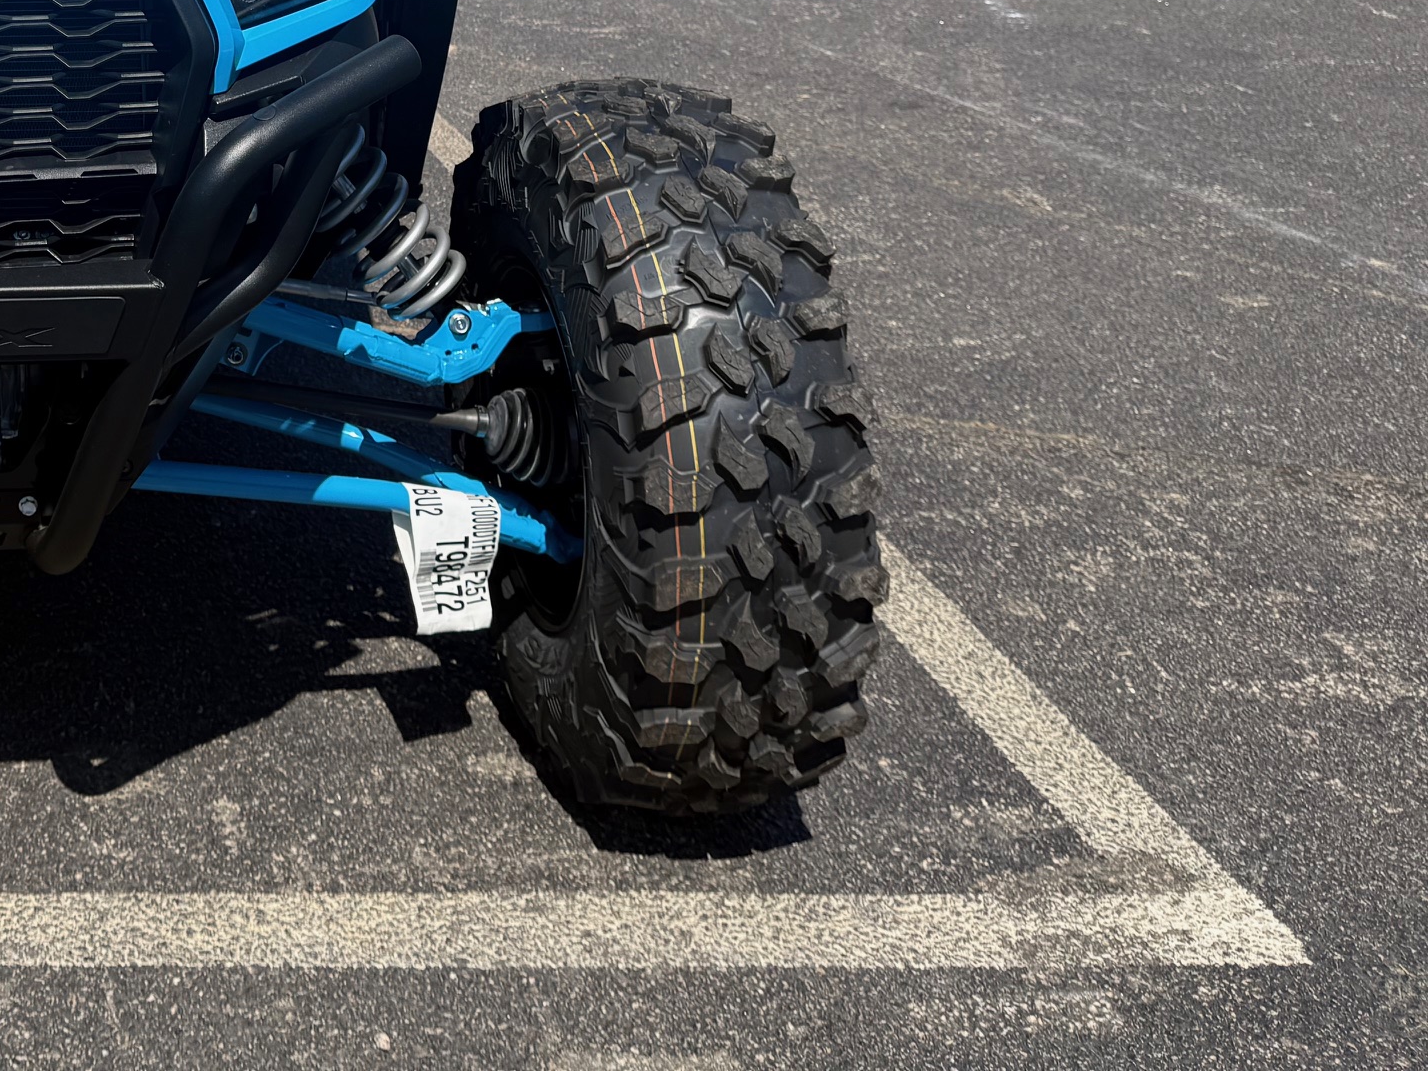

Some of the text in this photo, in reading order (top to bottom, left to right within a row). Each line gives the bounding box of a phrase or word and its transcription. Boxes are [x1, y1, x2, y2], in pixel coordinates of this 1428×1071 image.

[412, 488, 444, 517] BU2
[432, 535, 469, 615] T98472
[464, 494, 499, 605] F1000DTFNN F251
